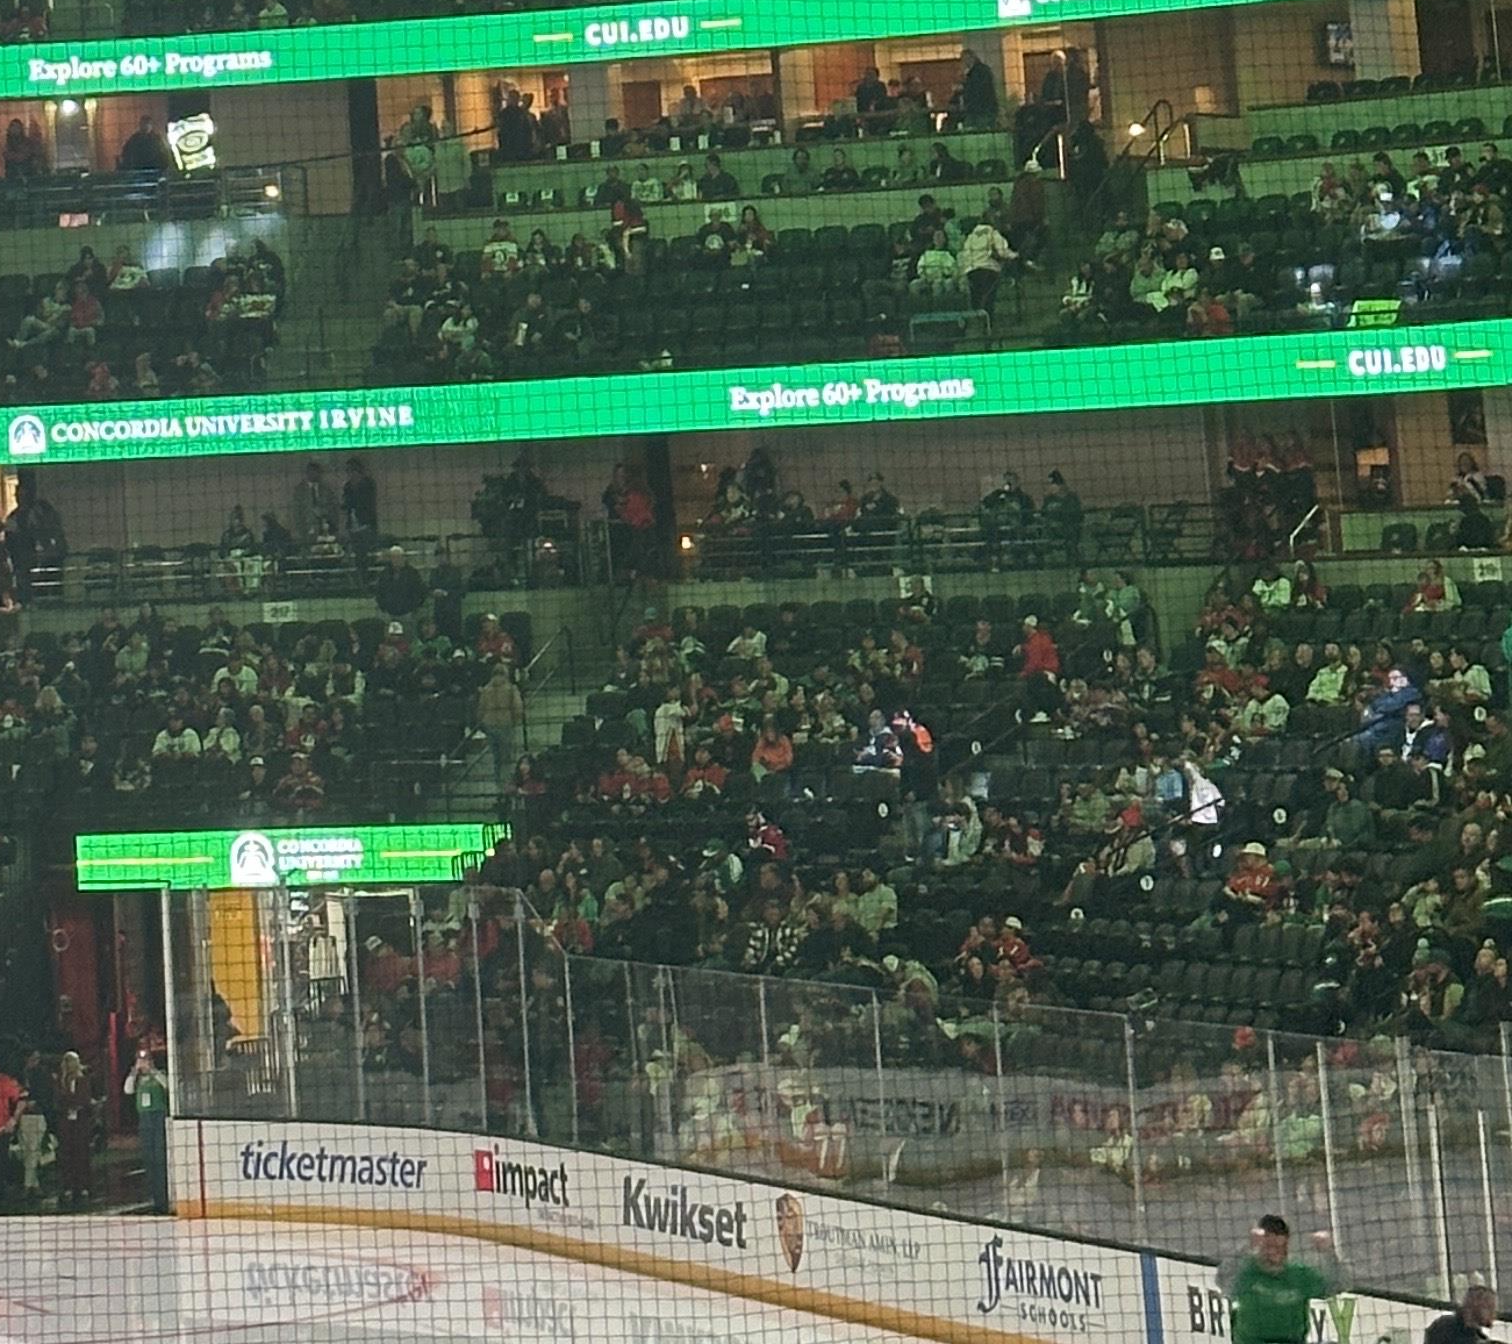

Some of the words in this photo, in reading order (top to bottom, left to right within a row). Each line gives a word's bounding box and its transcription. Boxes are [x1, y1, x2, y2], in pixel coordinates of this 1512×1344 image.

[584, 15, 690, 47] CUI.EDU
[28, 56, 117, 84] Explore
[120, 53, 162, 77] 60+
[164, 47, 273, 77] Programs
[1348, 346, 1446, 375] CUI.EDU
[730, 384, 820, 413] Explore
[822, 381, 862, 404] 60+
[864, 375, 975, 408] Programs
[50, 416, 182, 444] CONCORDIA
[183, 411, 313, 439] UNIVERSITY
[319, 405, 414, 429] IRVINE
[240, 1140, 427, 1190] ticketmaster
[494, 1143, 569, 1209] impact
[623, 1175, 747, 1249] Kwikset
[977, 1232, 1103, 1313] FAIRMONT
[1020, 1301, 1086, 1333] SCHOOLS
